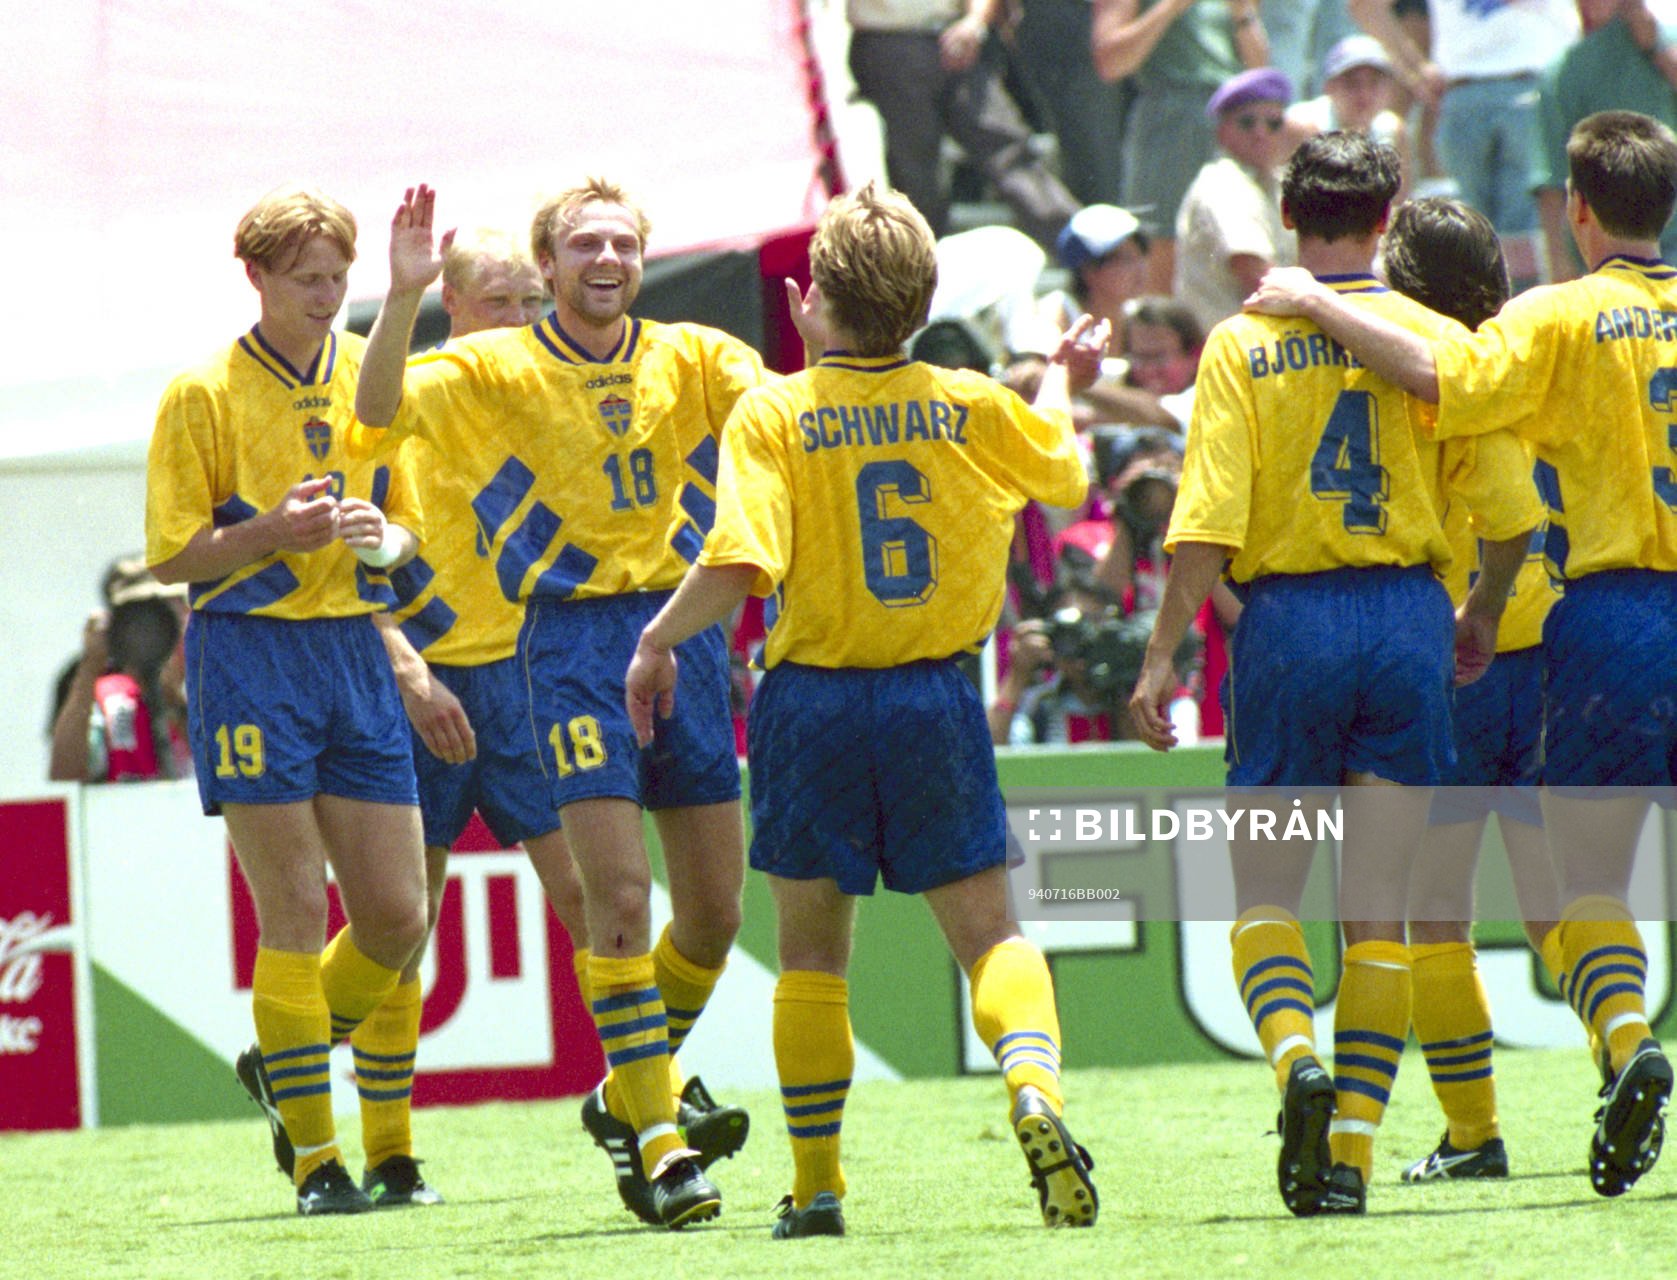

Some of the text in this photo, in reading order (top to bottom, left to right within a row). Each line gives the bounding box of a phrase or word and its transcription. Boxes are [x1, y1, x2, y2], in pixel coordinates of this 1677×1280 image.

[293, 395, 332, 410] adidas
[585, 371, 633, 390] adidas
[799, 400, 970, 453] SCHWARZ
[603, 447, 658, 512] 18
[1311, 390, 1390, 536] 4
[856, 459, 939, 608] 6
[214, 724, 267, 780] 19
[548, 715, 608, 780] 18
